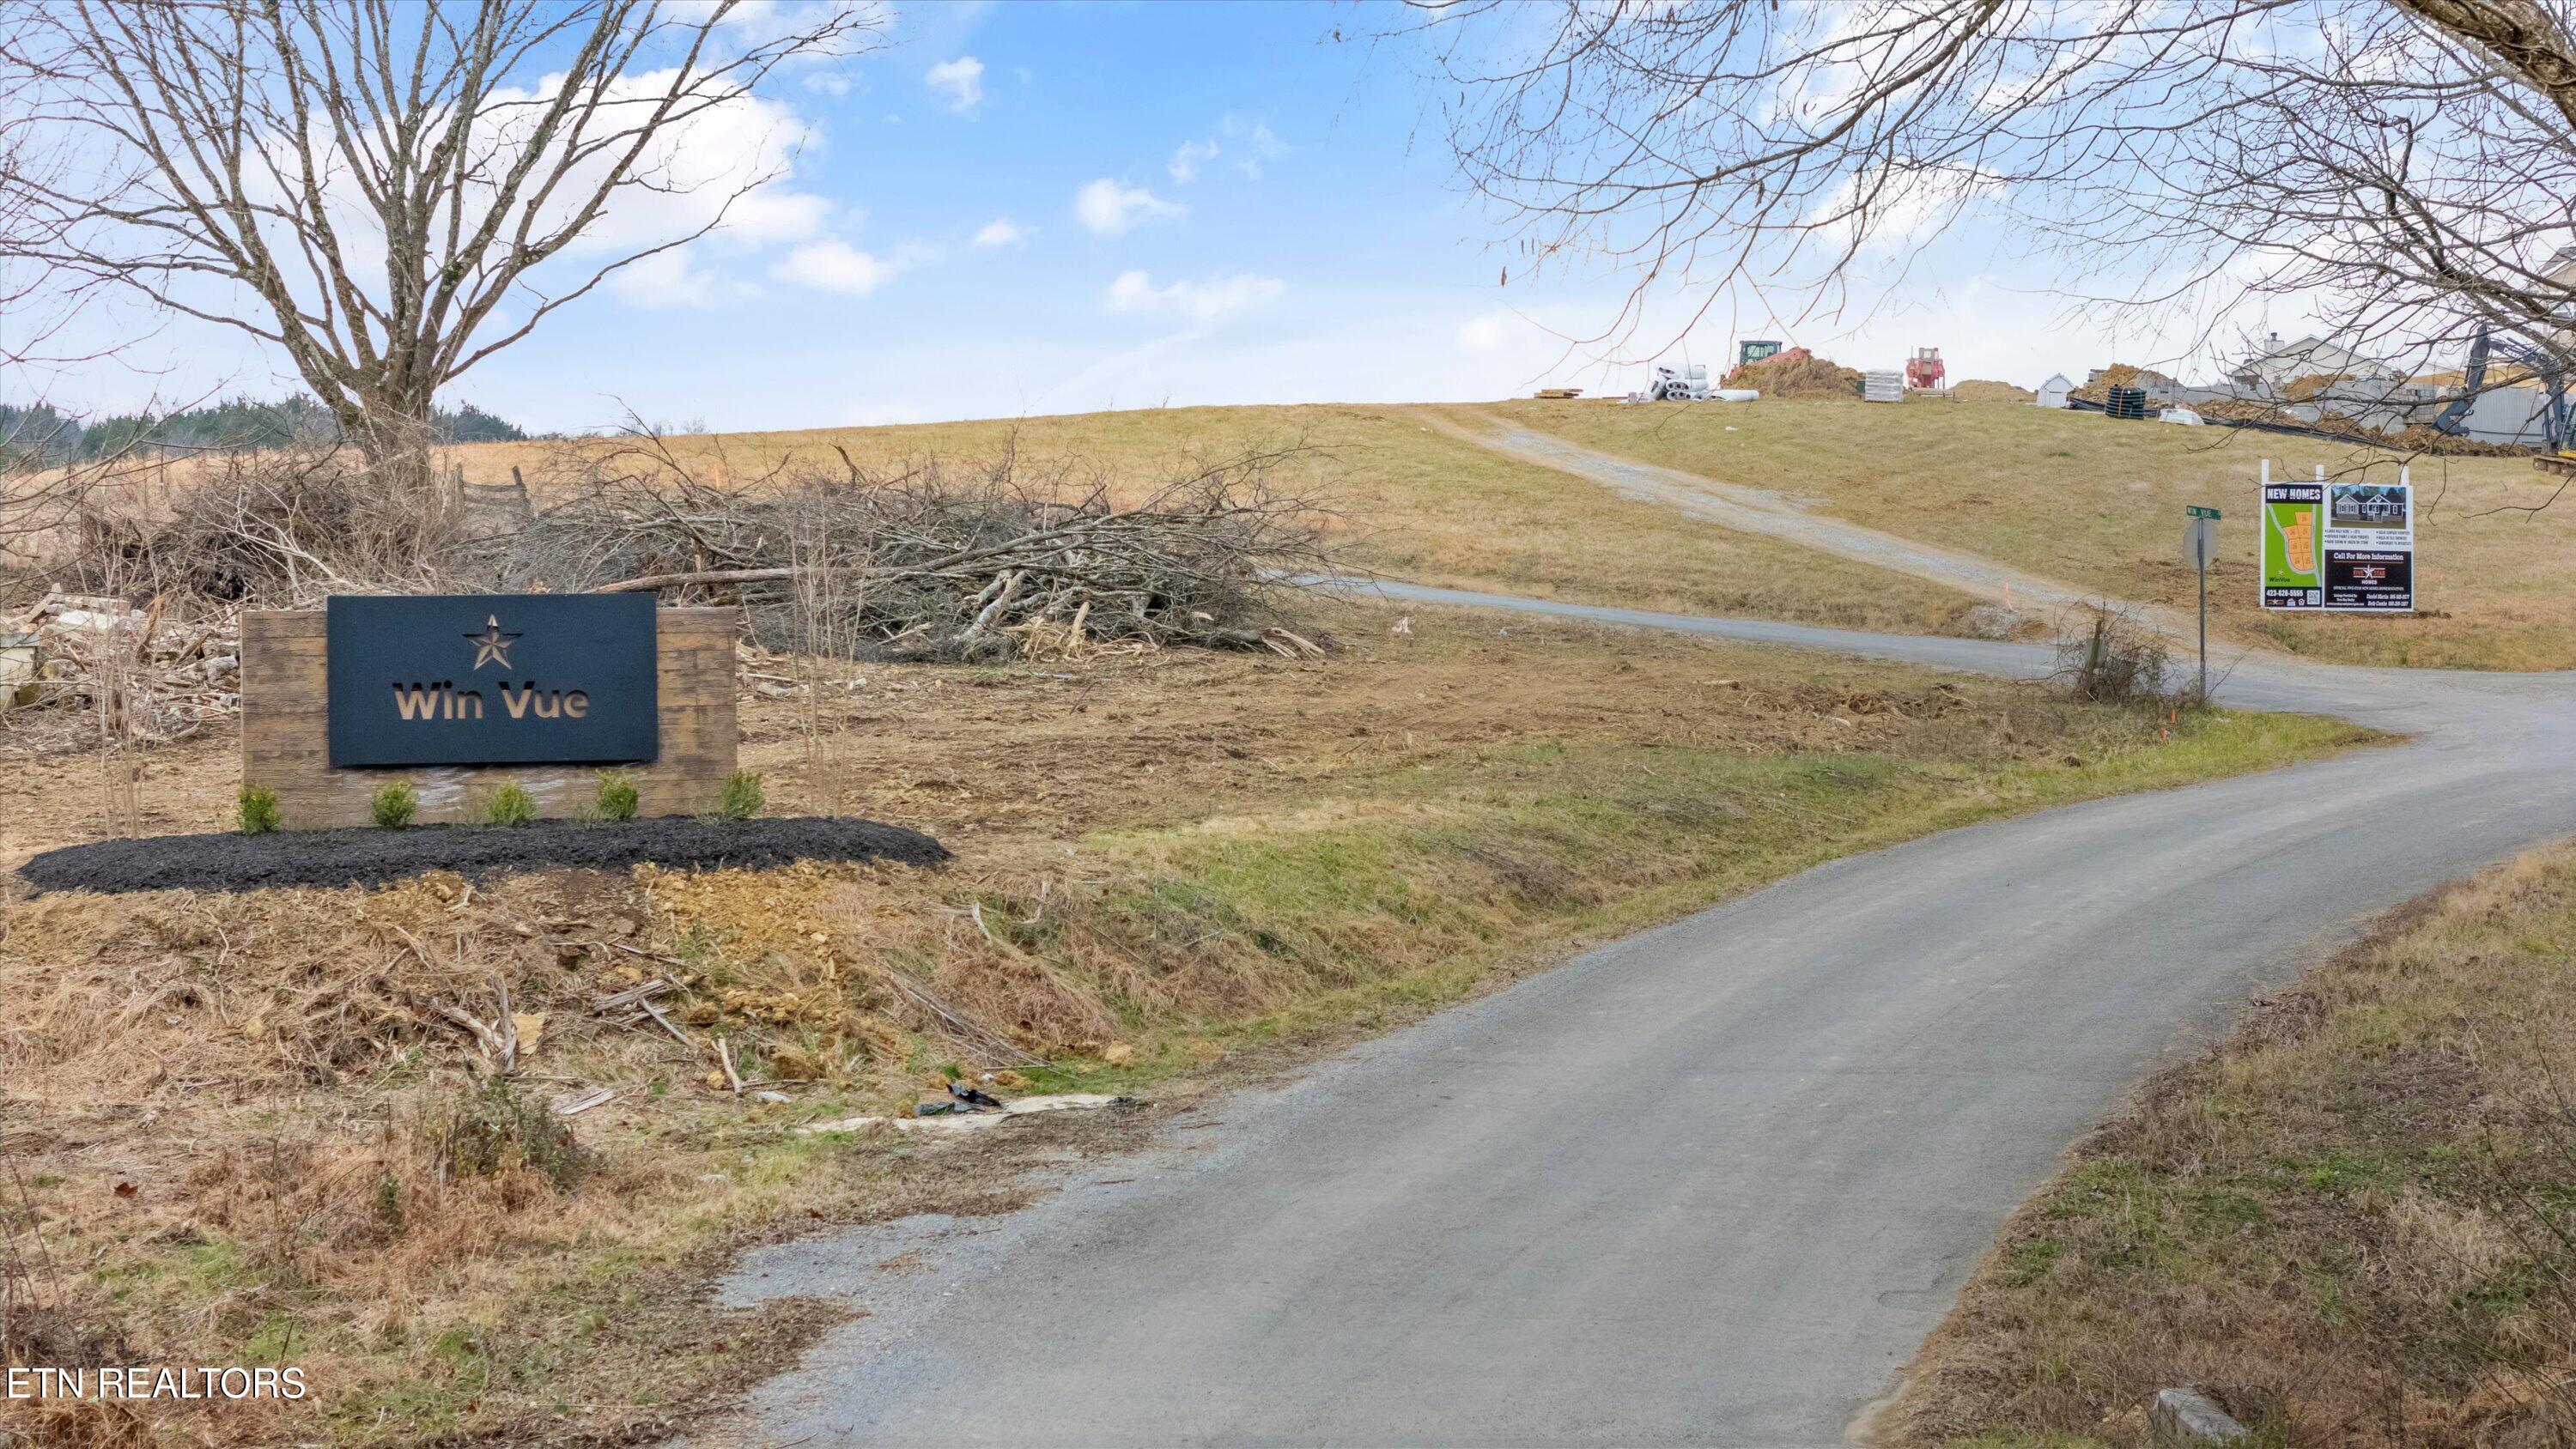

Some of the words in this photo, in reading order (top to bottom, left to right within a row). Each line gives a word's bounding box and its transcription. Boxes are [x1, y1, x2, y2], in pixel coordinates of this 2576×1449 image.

[2267, 488, 2287, 500] NEW
[2289, 488, 2321, 500] HOMES
[2200, 508, 2212, 518] VUE
[392, 680, 483, 720] Win
[498, 680, 590, 719] Vue
